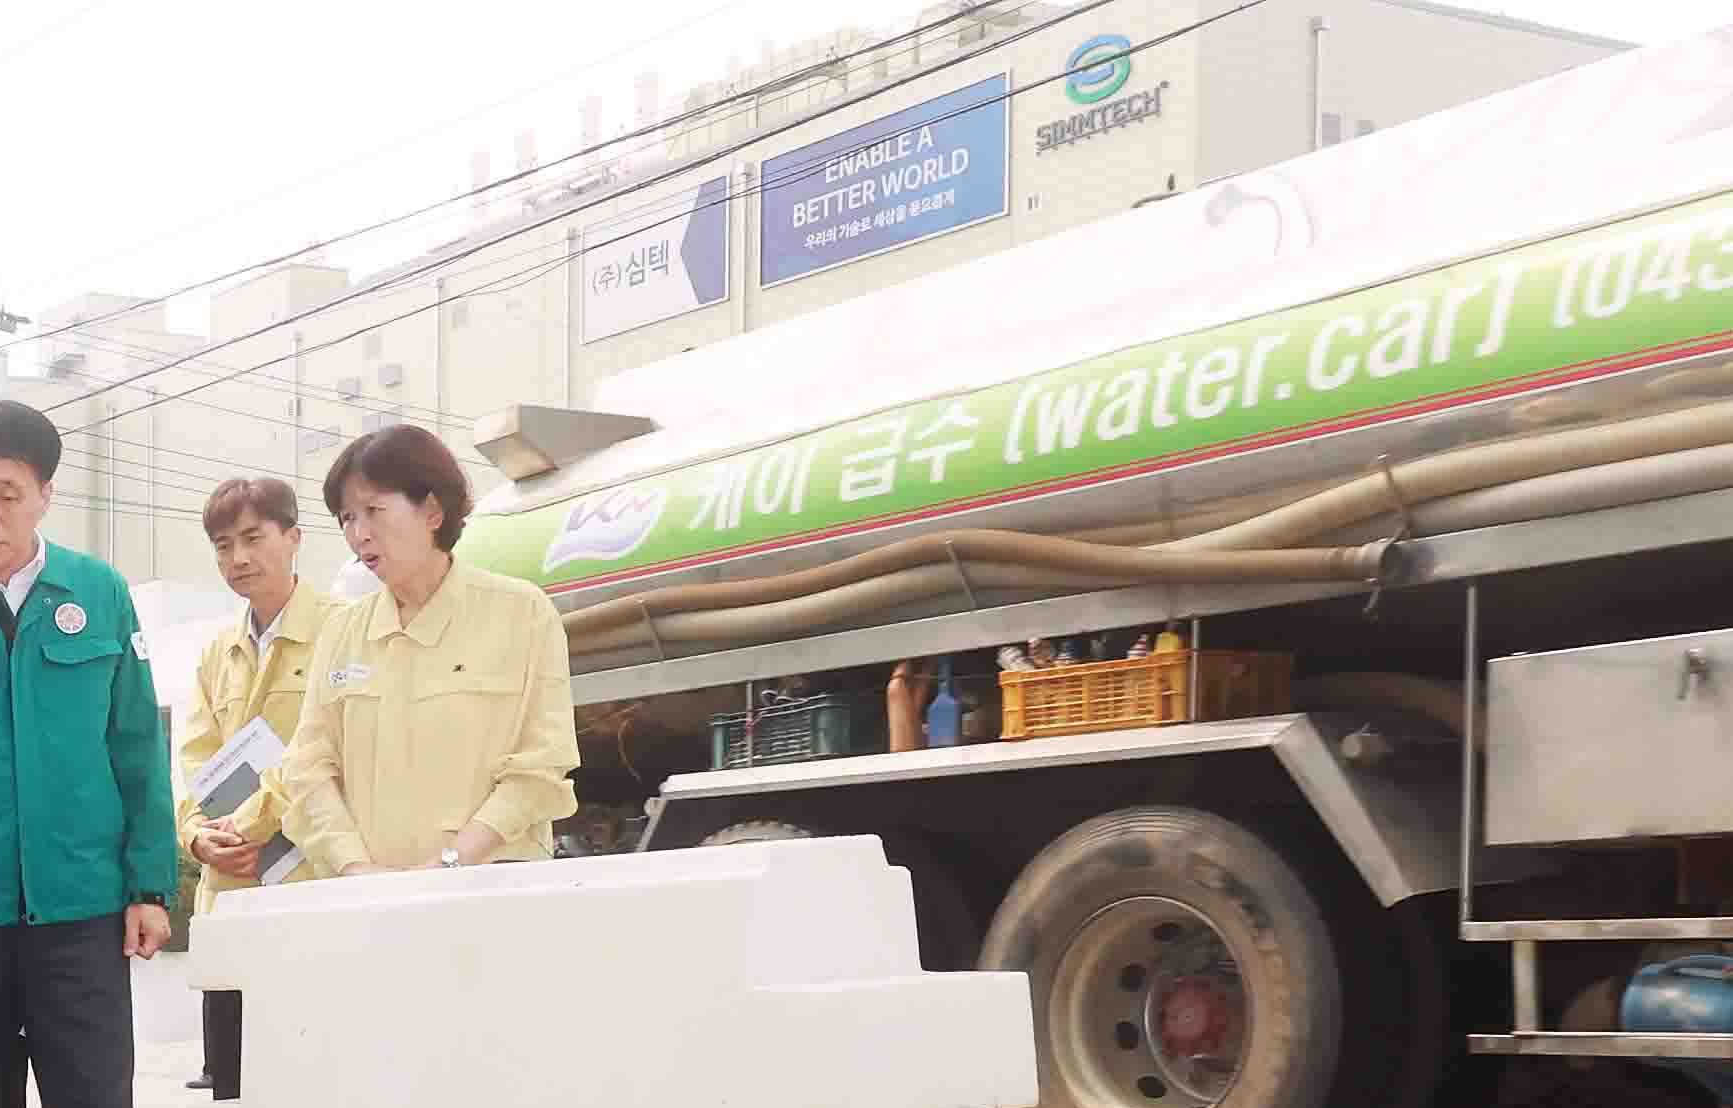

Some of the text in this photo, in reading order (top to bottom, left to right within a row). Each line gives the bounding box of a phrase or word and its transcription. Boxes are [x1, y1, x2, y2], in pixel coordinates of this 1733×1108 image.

[793, 147, 970, 229] BETTER WORLD
[825, 125, 935, 184] ENABLE A
[592, 239, 669, 297] (주)심텍
[688, 443, 819, 531] 케이
[838, 397, 982, 503] 급수
